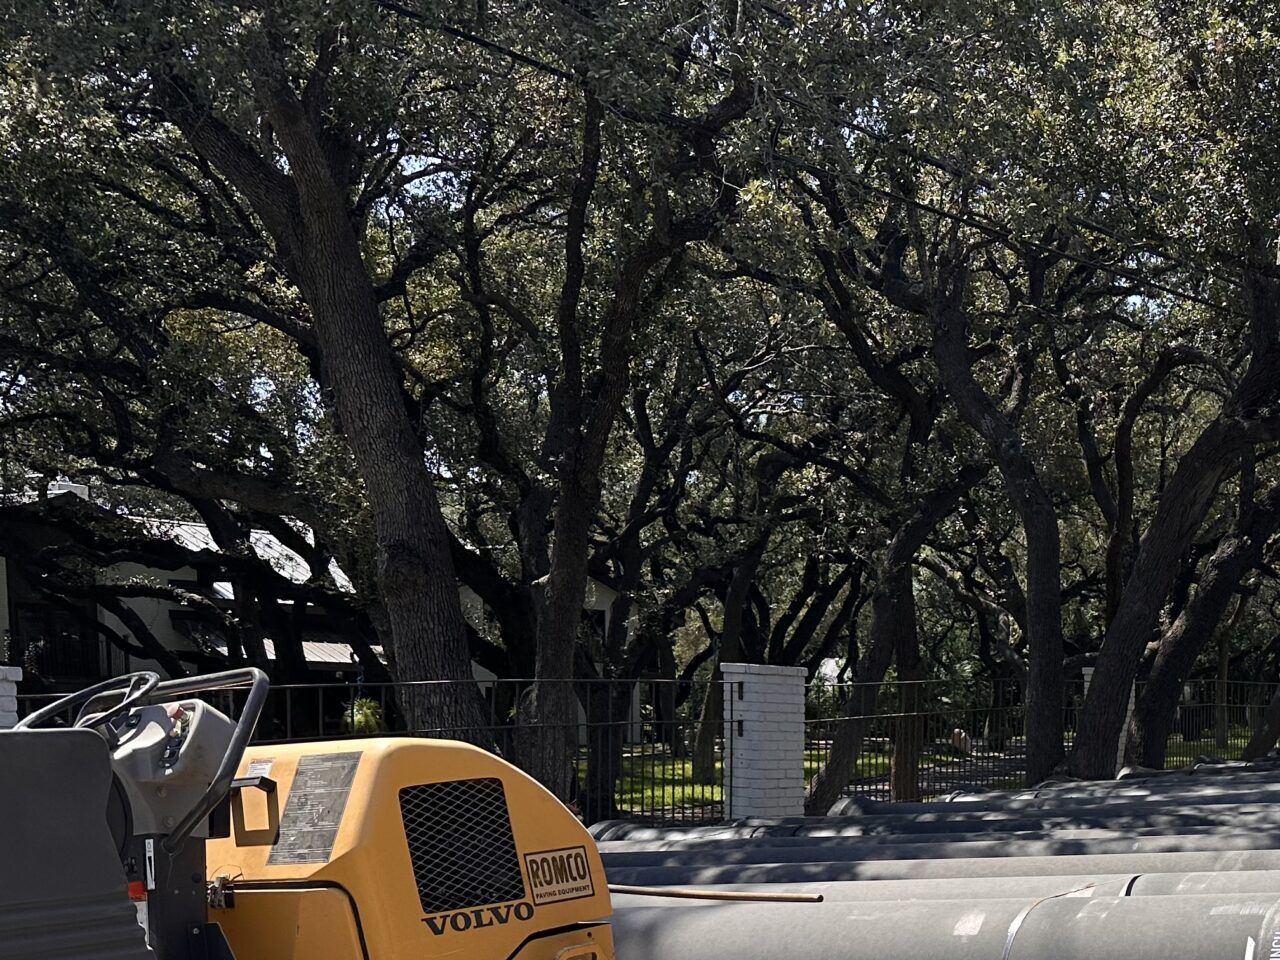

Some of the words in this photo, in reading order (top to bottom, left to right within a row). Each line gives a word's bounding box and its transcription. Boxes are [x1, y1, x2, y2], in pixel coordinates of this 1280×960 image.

[529, 852, 587, 888] ROMCO
[536, 890, 557, 900] PAVING
[557, 884, 590, 896] EQUIPMENT
[421, 902, 535, 936] VOLVO
